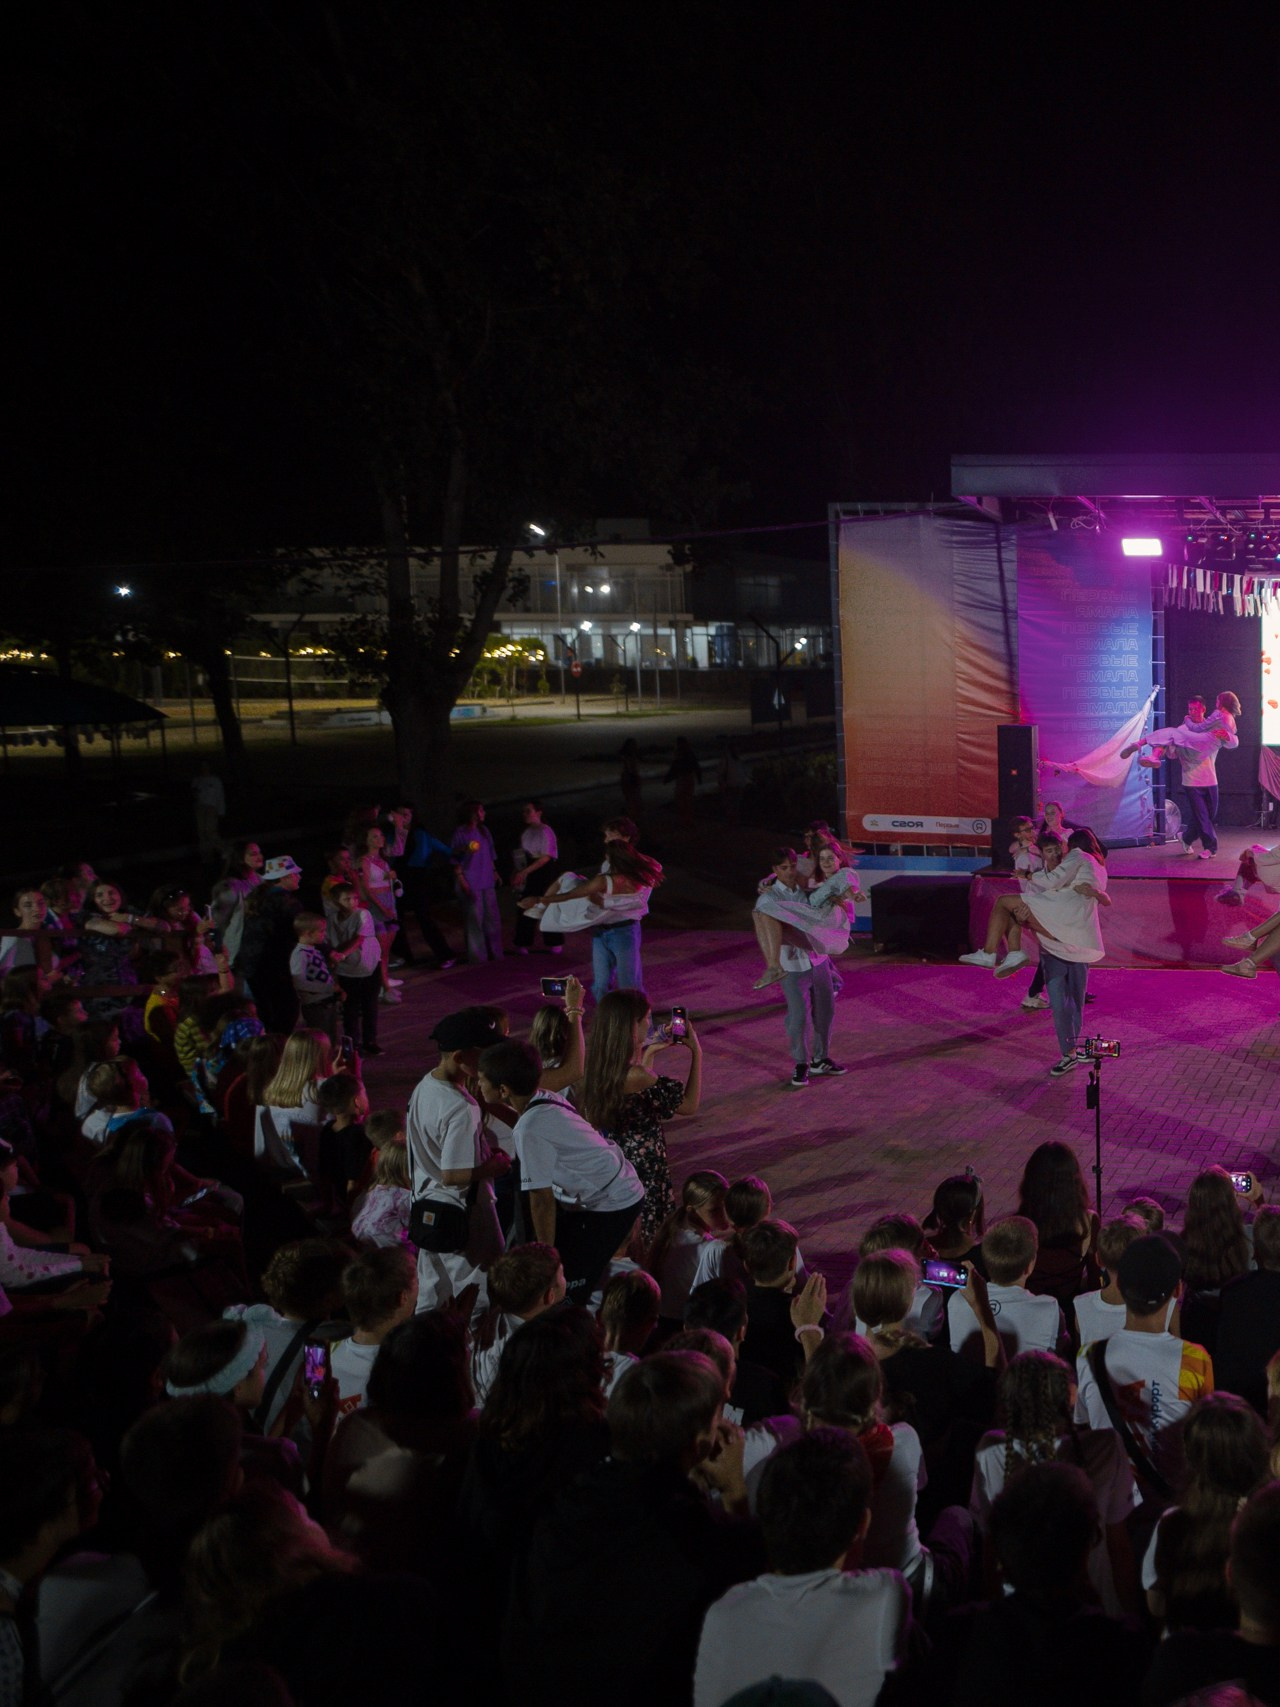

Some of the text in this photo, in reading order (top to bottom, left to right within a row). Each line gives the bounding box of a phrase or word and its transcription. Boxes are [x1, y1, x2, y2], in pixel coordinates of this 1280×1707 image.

[1075, 637, 1139, 651] ЯМАЛА
[1061, 654, 1139, 667] ПЕРВЫЕ
[1075, 670, 1139, 683] ЯМАЛА
